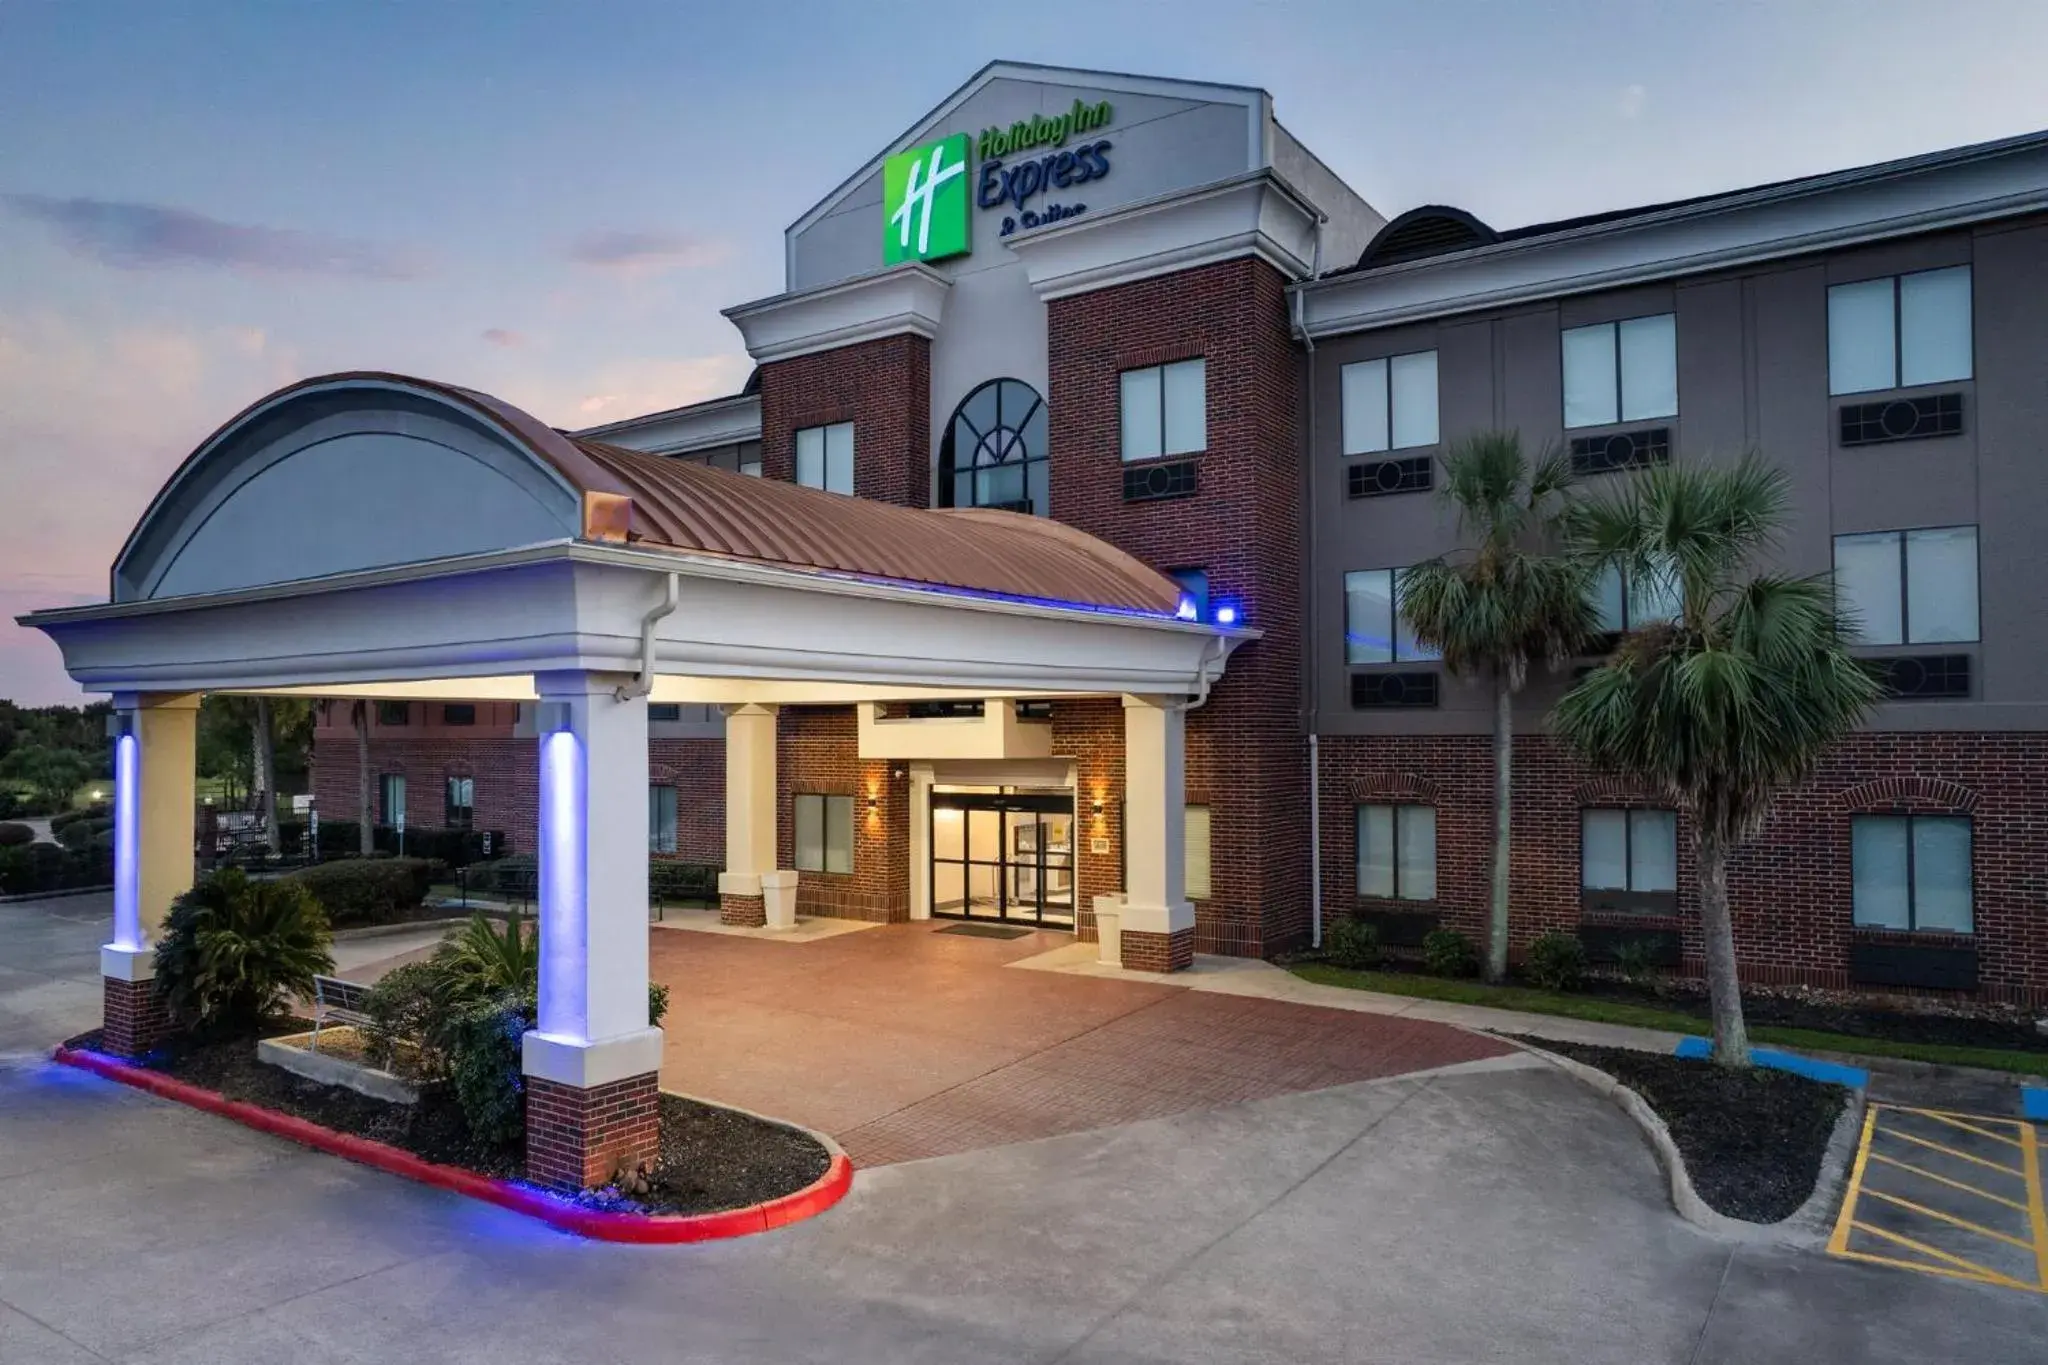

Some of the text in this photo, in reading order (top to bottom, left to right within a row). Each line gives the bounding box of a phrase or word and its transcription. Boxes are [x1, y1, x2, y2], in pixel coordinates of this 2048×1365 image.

[978, 98, 1112, 160] Holiday Inn
[891, 145, 965, 254] H
[977, 140, 1112, 211] Express
